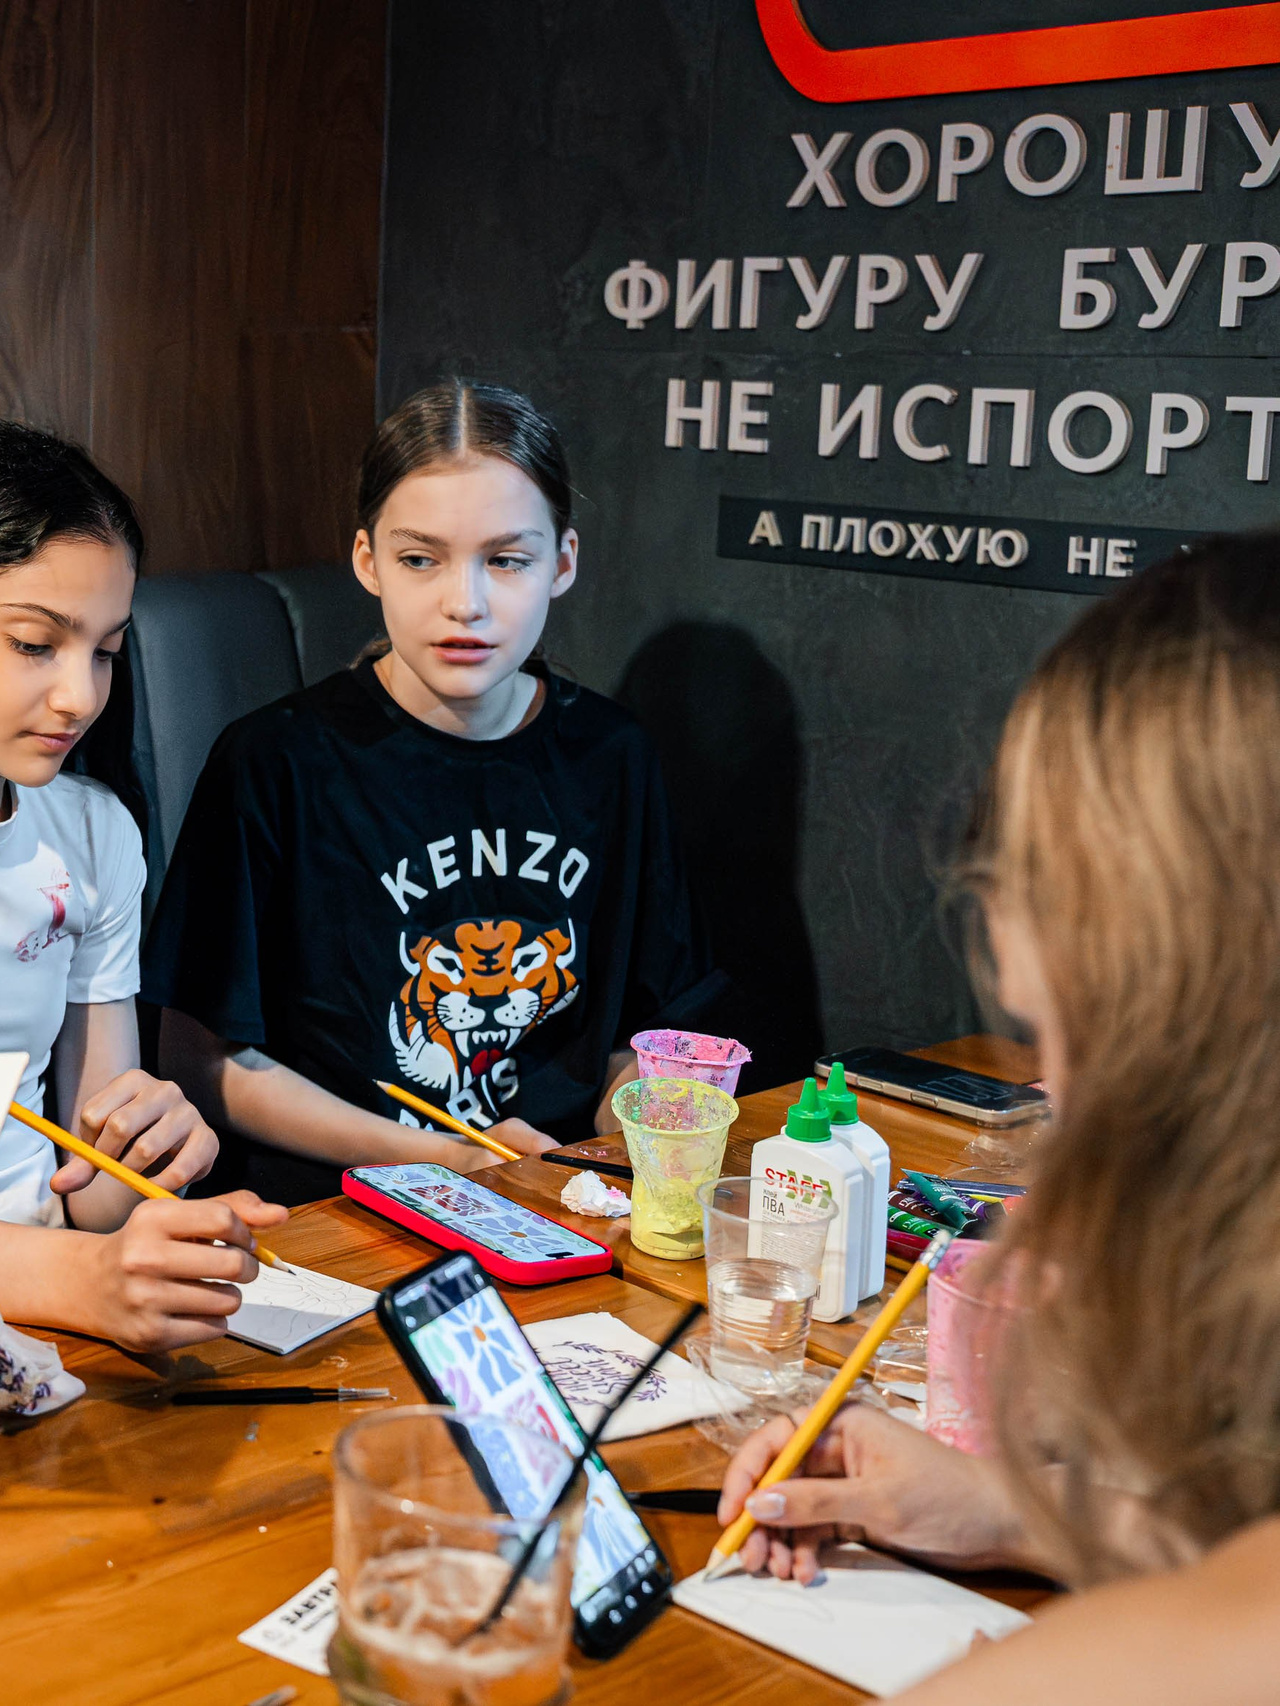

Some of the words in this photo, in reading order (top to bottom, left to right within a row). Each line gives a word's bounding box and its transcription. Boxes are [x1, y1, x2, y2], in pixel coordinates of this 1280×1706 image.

[604, 253, 984, 331] ФИГУРУ
[1060, 242, 1280, 330] БУР
[665, 378, 774, 453] НЕ
[818, 384, 1280, 480] ИСПОРТ
[749, 511, 782, 547] А
[801, 515, 1029, 568] ПЛОХУЮ
[1067, 535, 1137, 578] НЕ
[380, 828, 590, 914] KENZO
[762, 1196, 785, 1216] ПВА
[764, 1167, 826, 1199] STAFF
